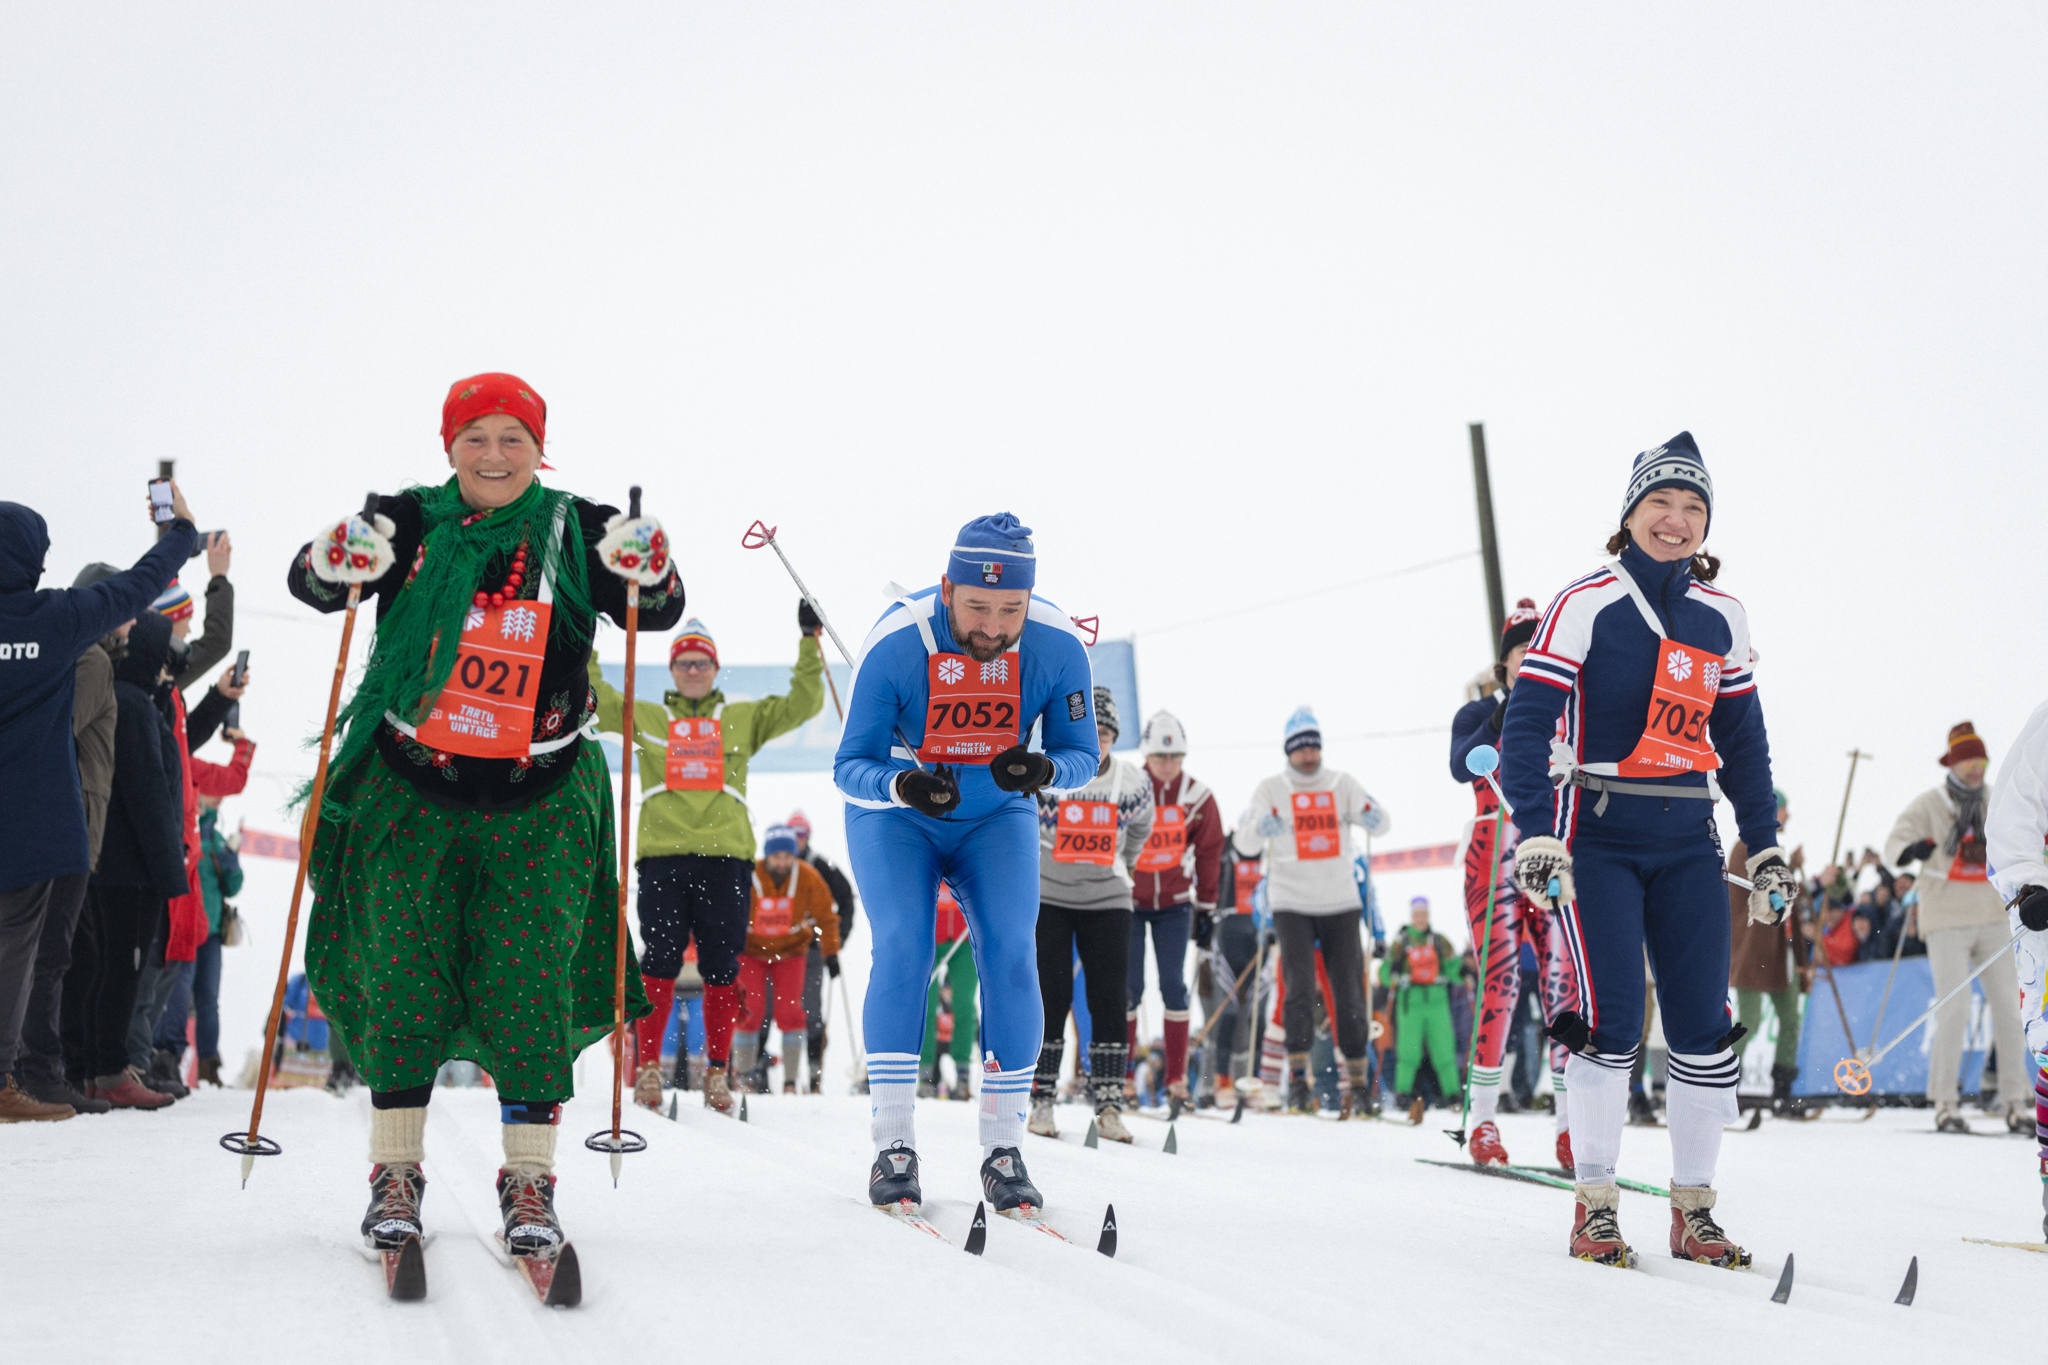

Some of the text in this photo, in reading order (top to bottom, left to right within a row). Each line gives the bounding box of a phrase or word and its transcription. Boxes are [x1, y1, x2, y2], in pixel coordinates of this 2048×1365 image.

[1622, 469, 1662, 510] RTU
[455, 654, 530, 698] 021
[460, 703, 495, 723] TARTU
[931, 702, 1014, 730] 7052
[450, 721, 498, 739] VINTAGE
[930, 745, 941, 754] 20
[946, 745, 992, 755] MARATON
[1664, 752, 1693, 770] TARTU
[1059, 833, 1112, 852] 7058
[1150, 831, 1182, 849] 014
